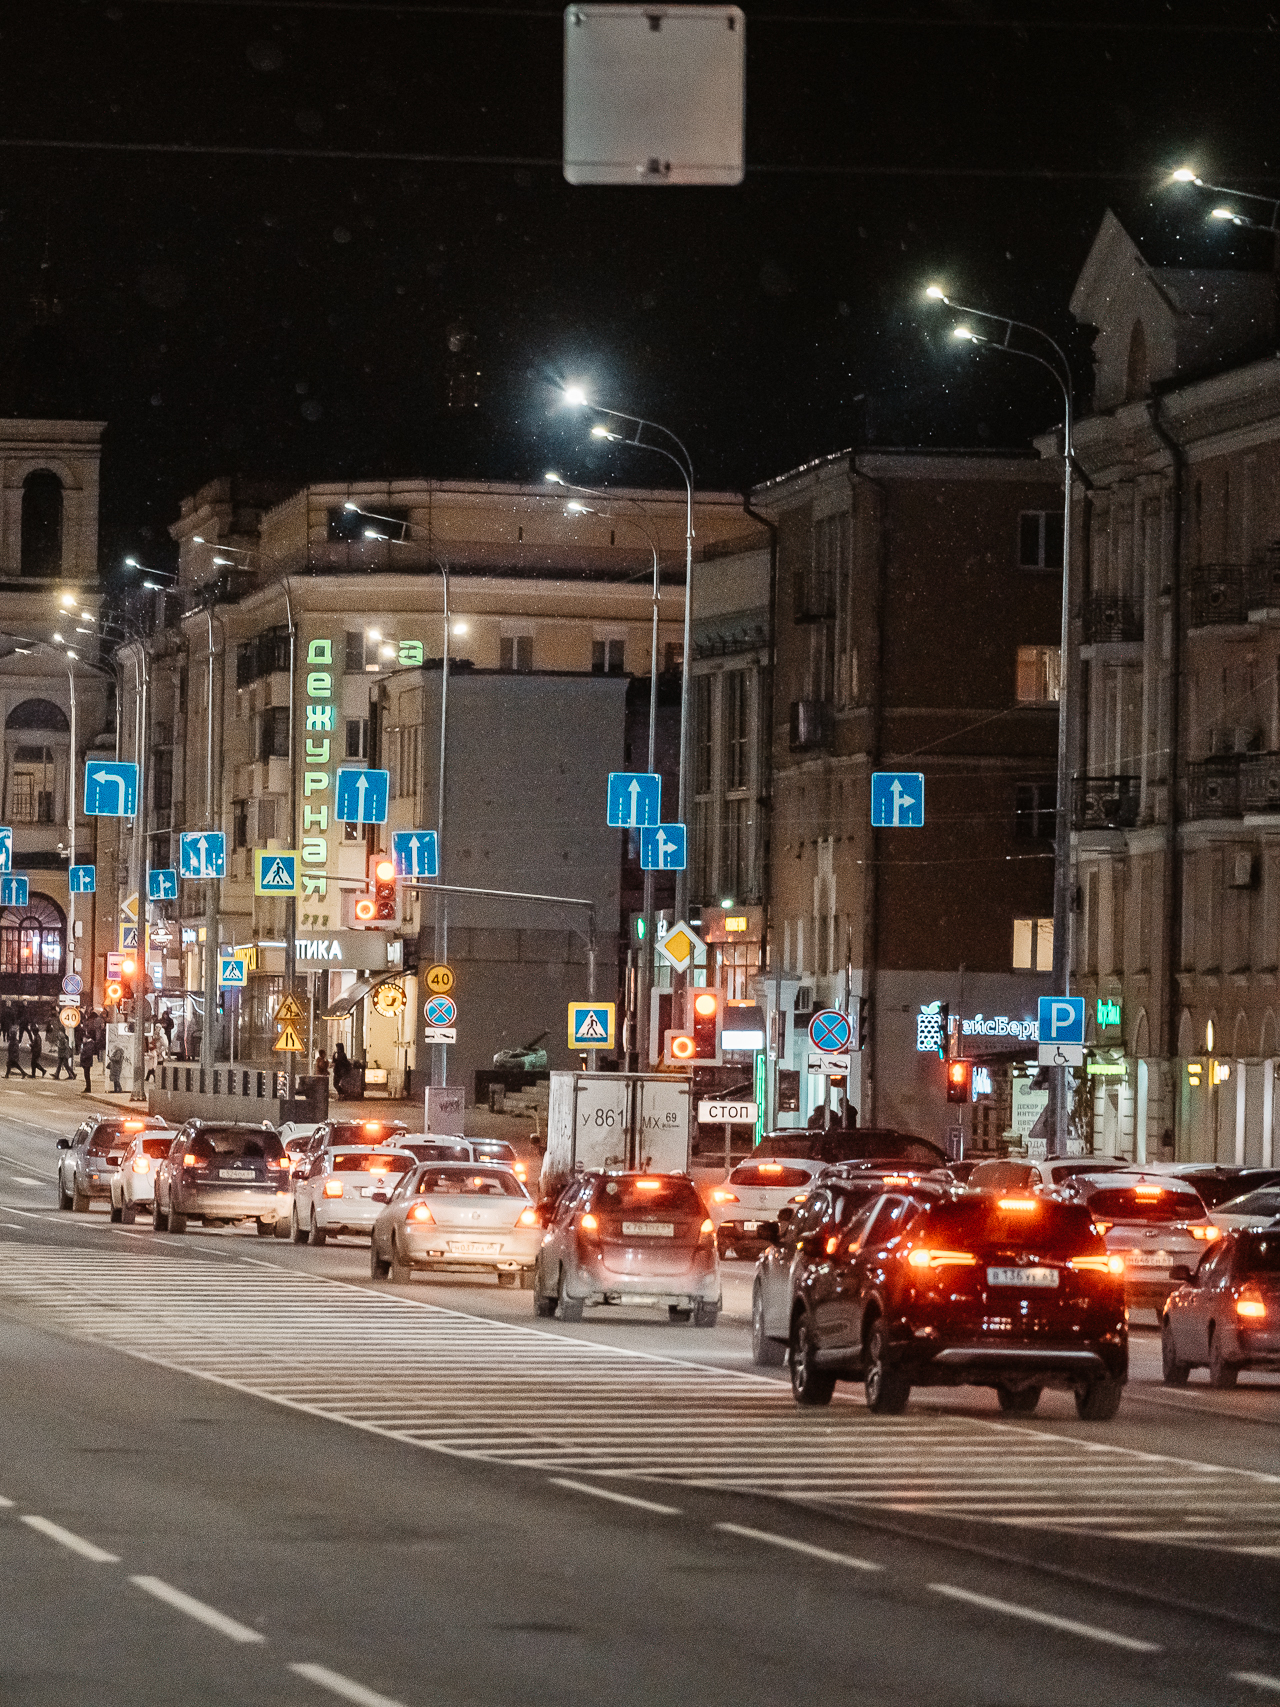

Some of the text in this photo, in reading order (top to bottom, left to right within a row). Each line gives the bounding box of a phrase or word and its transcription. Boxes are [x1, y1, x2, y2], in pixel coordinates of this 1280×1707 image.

[431, 973, 450, 985] 40
[64, 1013, 77, 1021] 40
[1051, 1002, 1076, 1038] P
[594, 1108, 624, 1127] 861
[665, 1112, 677, 1123] 69
[708, 1106, 749, 1118] СТОП
